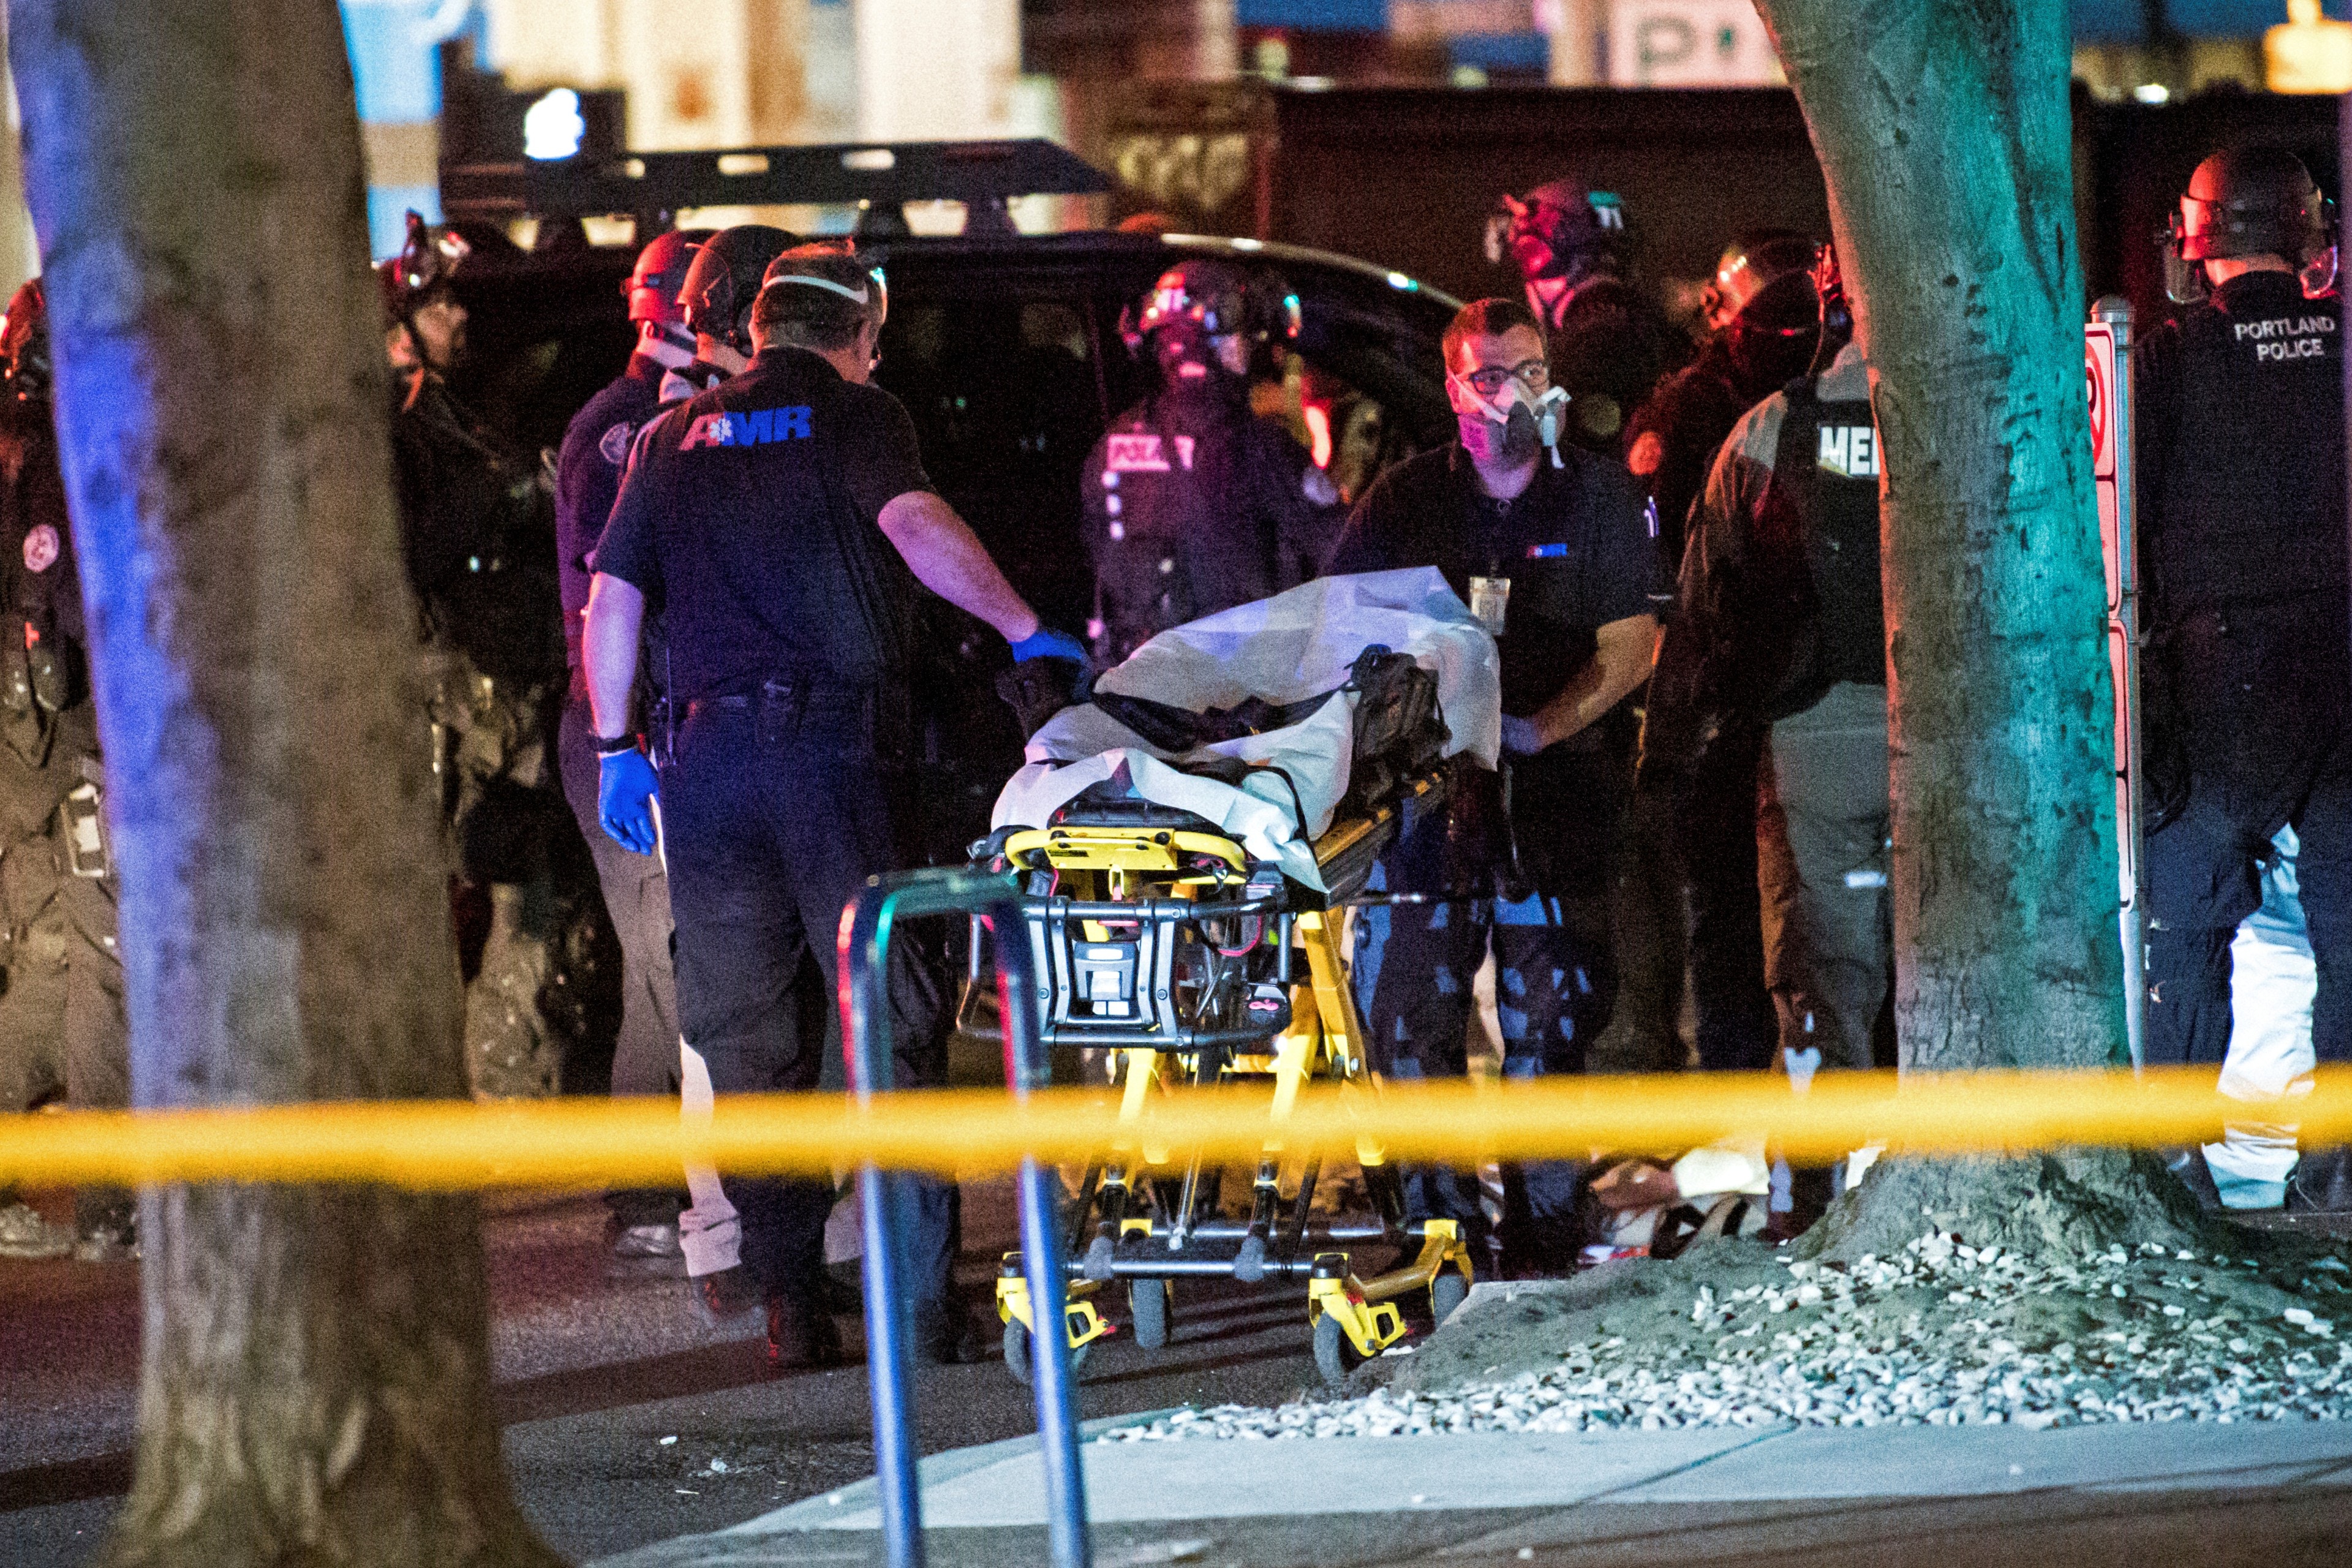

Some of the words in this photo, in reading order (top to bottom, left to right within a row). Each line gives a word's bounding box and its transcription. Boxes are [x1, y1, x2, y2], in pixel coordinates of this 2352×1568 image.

[2234, 316, 2335, 340] PORTLAND
[2256, 338, 2324, 361] POLICE
[679, 406, 812, 451] AMR
[1820, 426, 1879, 475] ME
